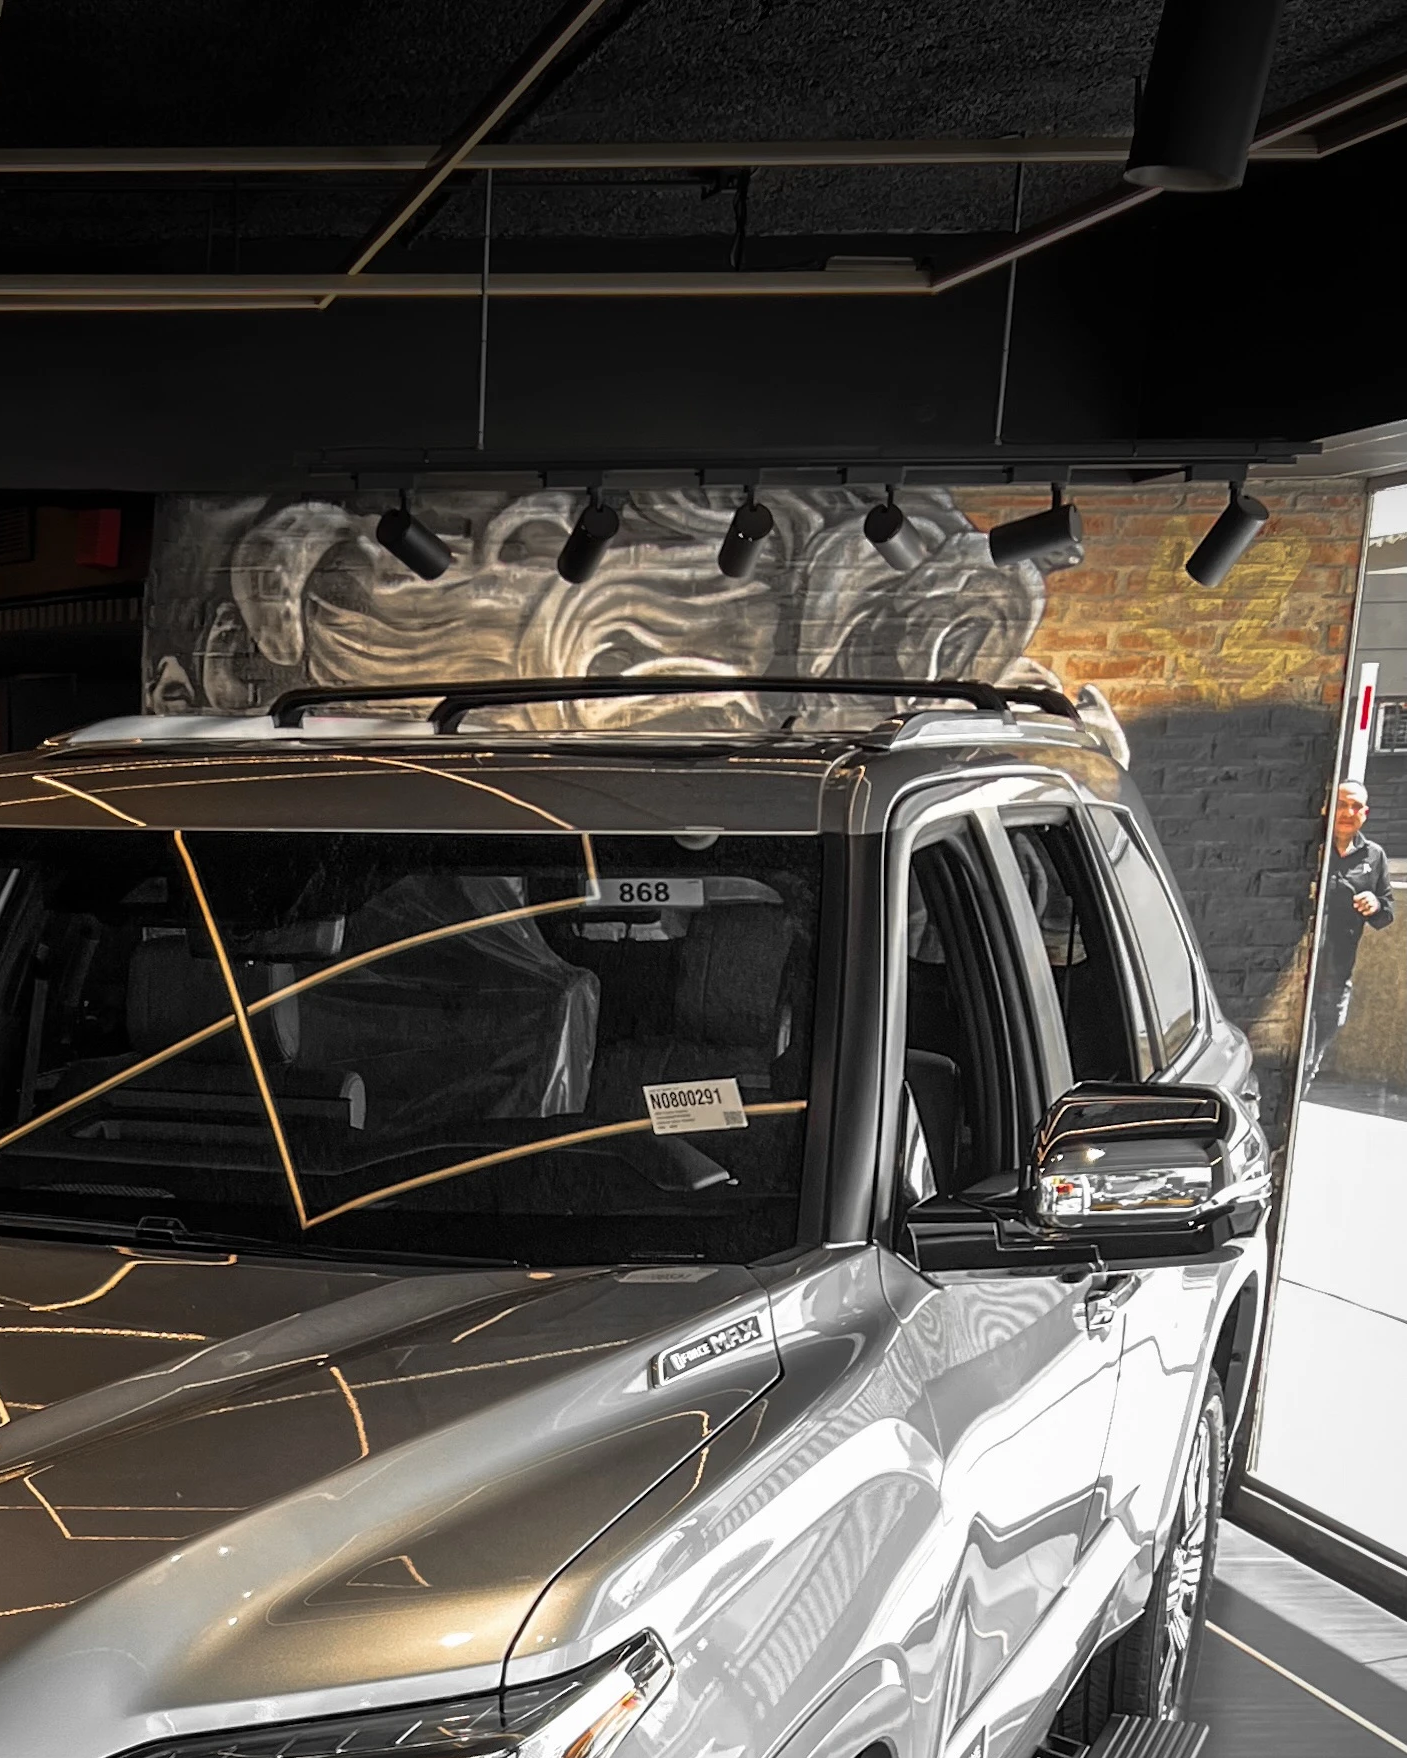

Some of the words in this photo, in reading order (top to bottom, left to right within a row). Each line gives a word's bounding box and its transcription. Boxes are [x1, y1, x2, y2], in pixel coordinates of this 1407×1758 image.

[619, 882, 670, 903] 868
[650, 1087, 722, 1110] N0800291
[709, 1320, 760, 1354] MAX
